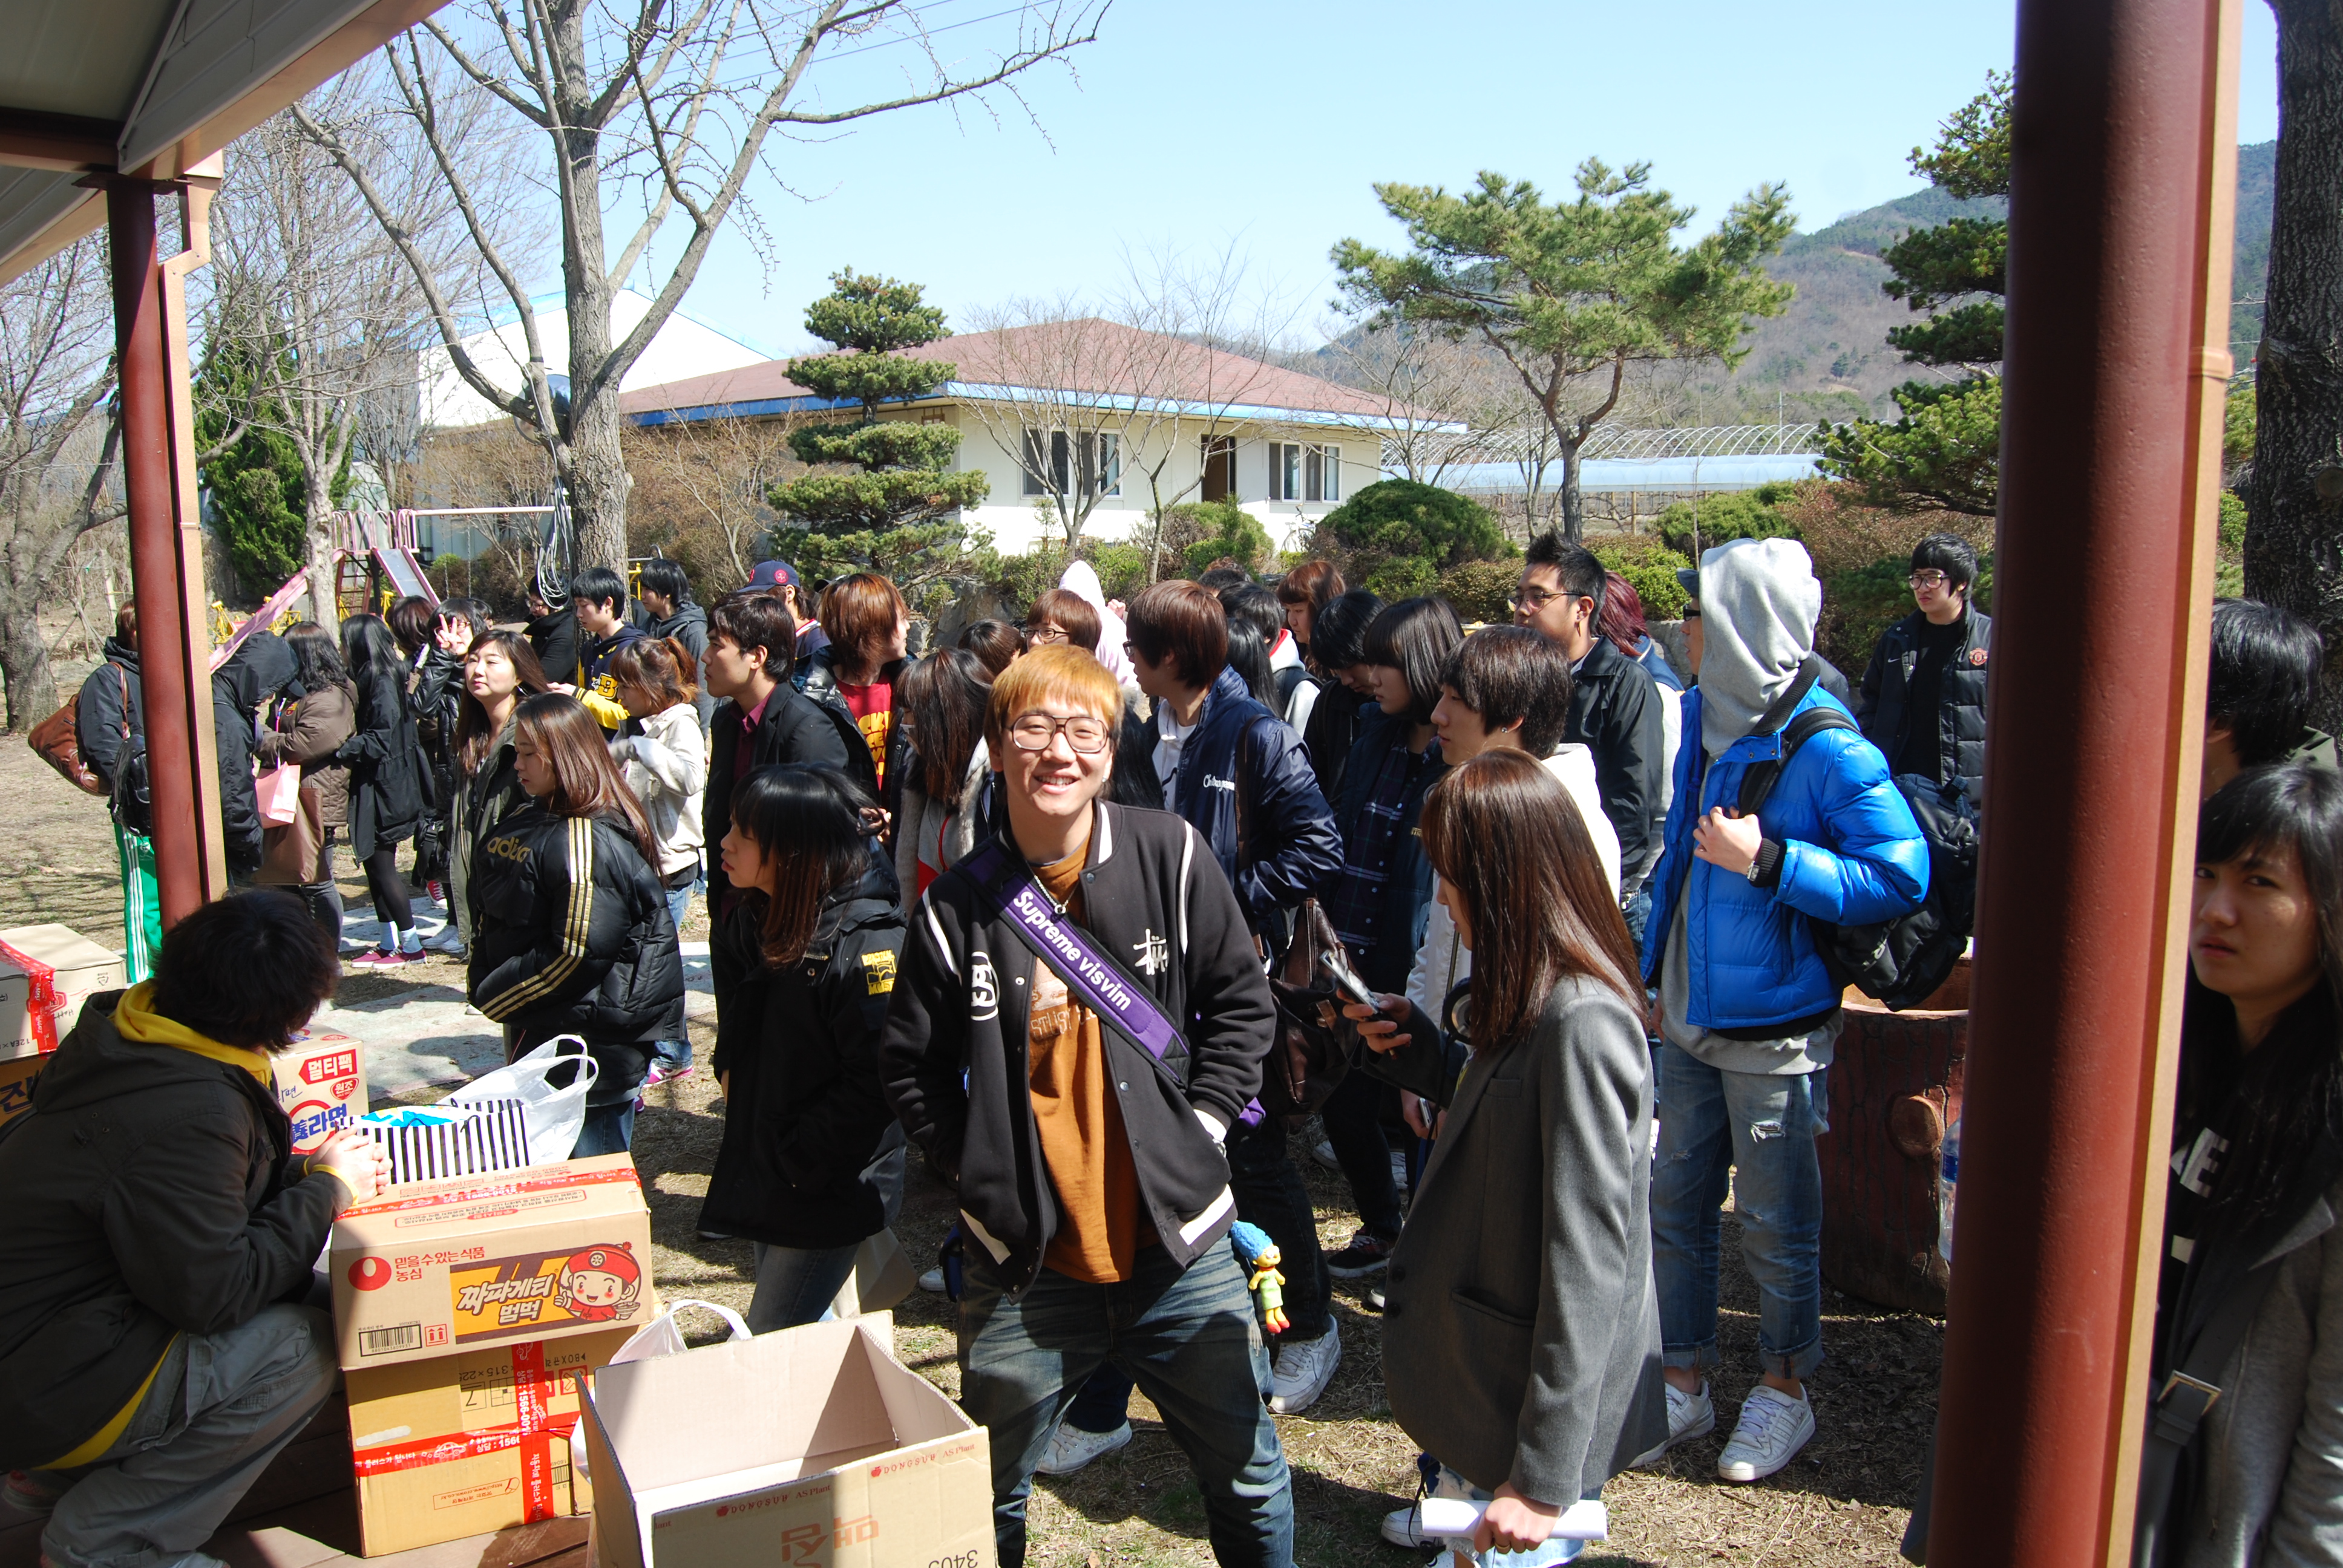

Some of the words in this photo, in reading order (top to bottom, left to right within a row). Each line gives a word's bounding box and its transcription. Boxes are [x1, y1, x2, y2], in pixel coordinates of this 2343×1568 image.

[1013, 891, 1081, 961] Supreme
[1079, 956, 1132, 1011] visvim
[10, 1038, 31, 1049] 12EA
[307, 1053, 353, 1082] 멀티팩
[335, 1079, 354, 1094] 원조
[395, 1255, 419, 1269] 믿을
[421, 1253, 434, 1266] 수
[434, 1251, 459, 1264] 있는
[460, 1246, 485, 1259] 식품
[396, 1268, 422, 1282] 농심
[456, 1273, 554, 1315] 짜파게티
[499, 1299, 542, 1324] 범벅
[487, 1365, 509, 1377] 315
[884, 1453, 936, 1474] DONGSUH
[955, 1444, 975, 1454] Plant
[731, 1494, 790, 1514] DONGSUH
[810, 1484, 831, 1497] Plant
[655, 1520, 672, 1529] lant
